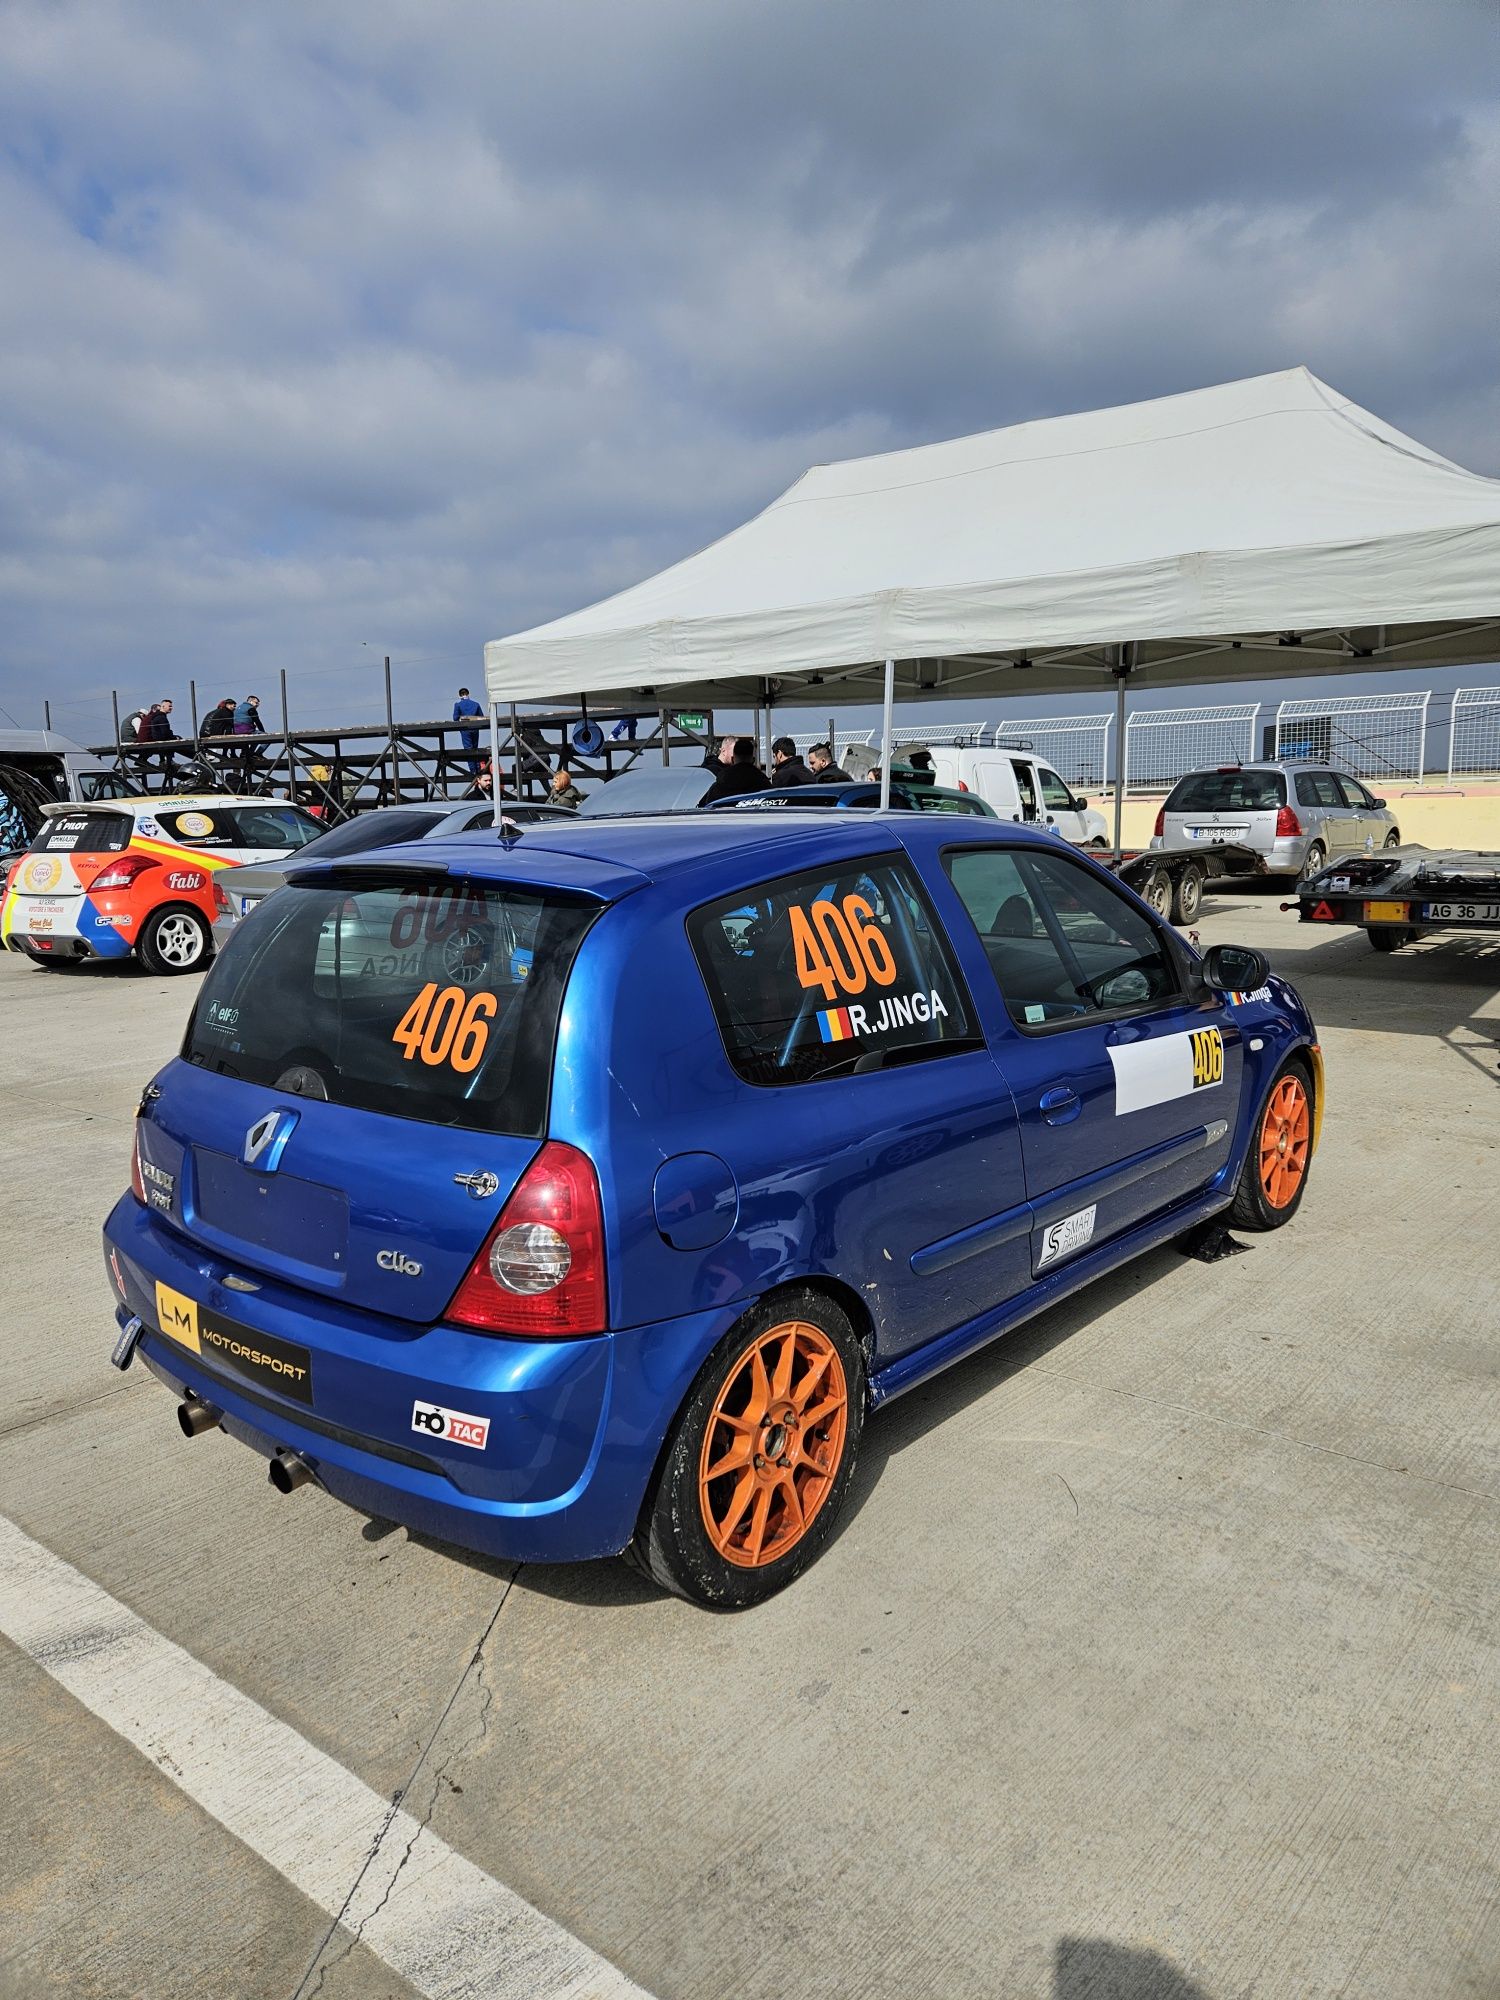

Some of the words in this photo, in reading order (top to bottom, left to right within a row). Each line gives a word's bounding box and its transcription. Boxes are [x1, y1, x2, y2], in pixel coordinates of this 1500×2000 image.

[63, 822, 88, 830] PILOT
[169, 872, 200, 888] Fabi
[1431, 905, 1451, 918] AG
[1457, 906, 1475, 918] 36
[1482, 908, 1500, 919] JJ
[788, 894, 897, 1000] 406
[392, 982, 498, 1073] 406
[848, 989, 948, 1037] R.JINGA
[1193, 1029, 1222, 1085] 406
[1064, 1209, 1096, 1238] SMART
[376, 1250, 421, 1276] Clio
[160, 1297, 191, 1333] LM
[202, 1328, 306, 1381] MOTORSPORT
[452, 1421, 484, 1443] TAC
